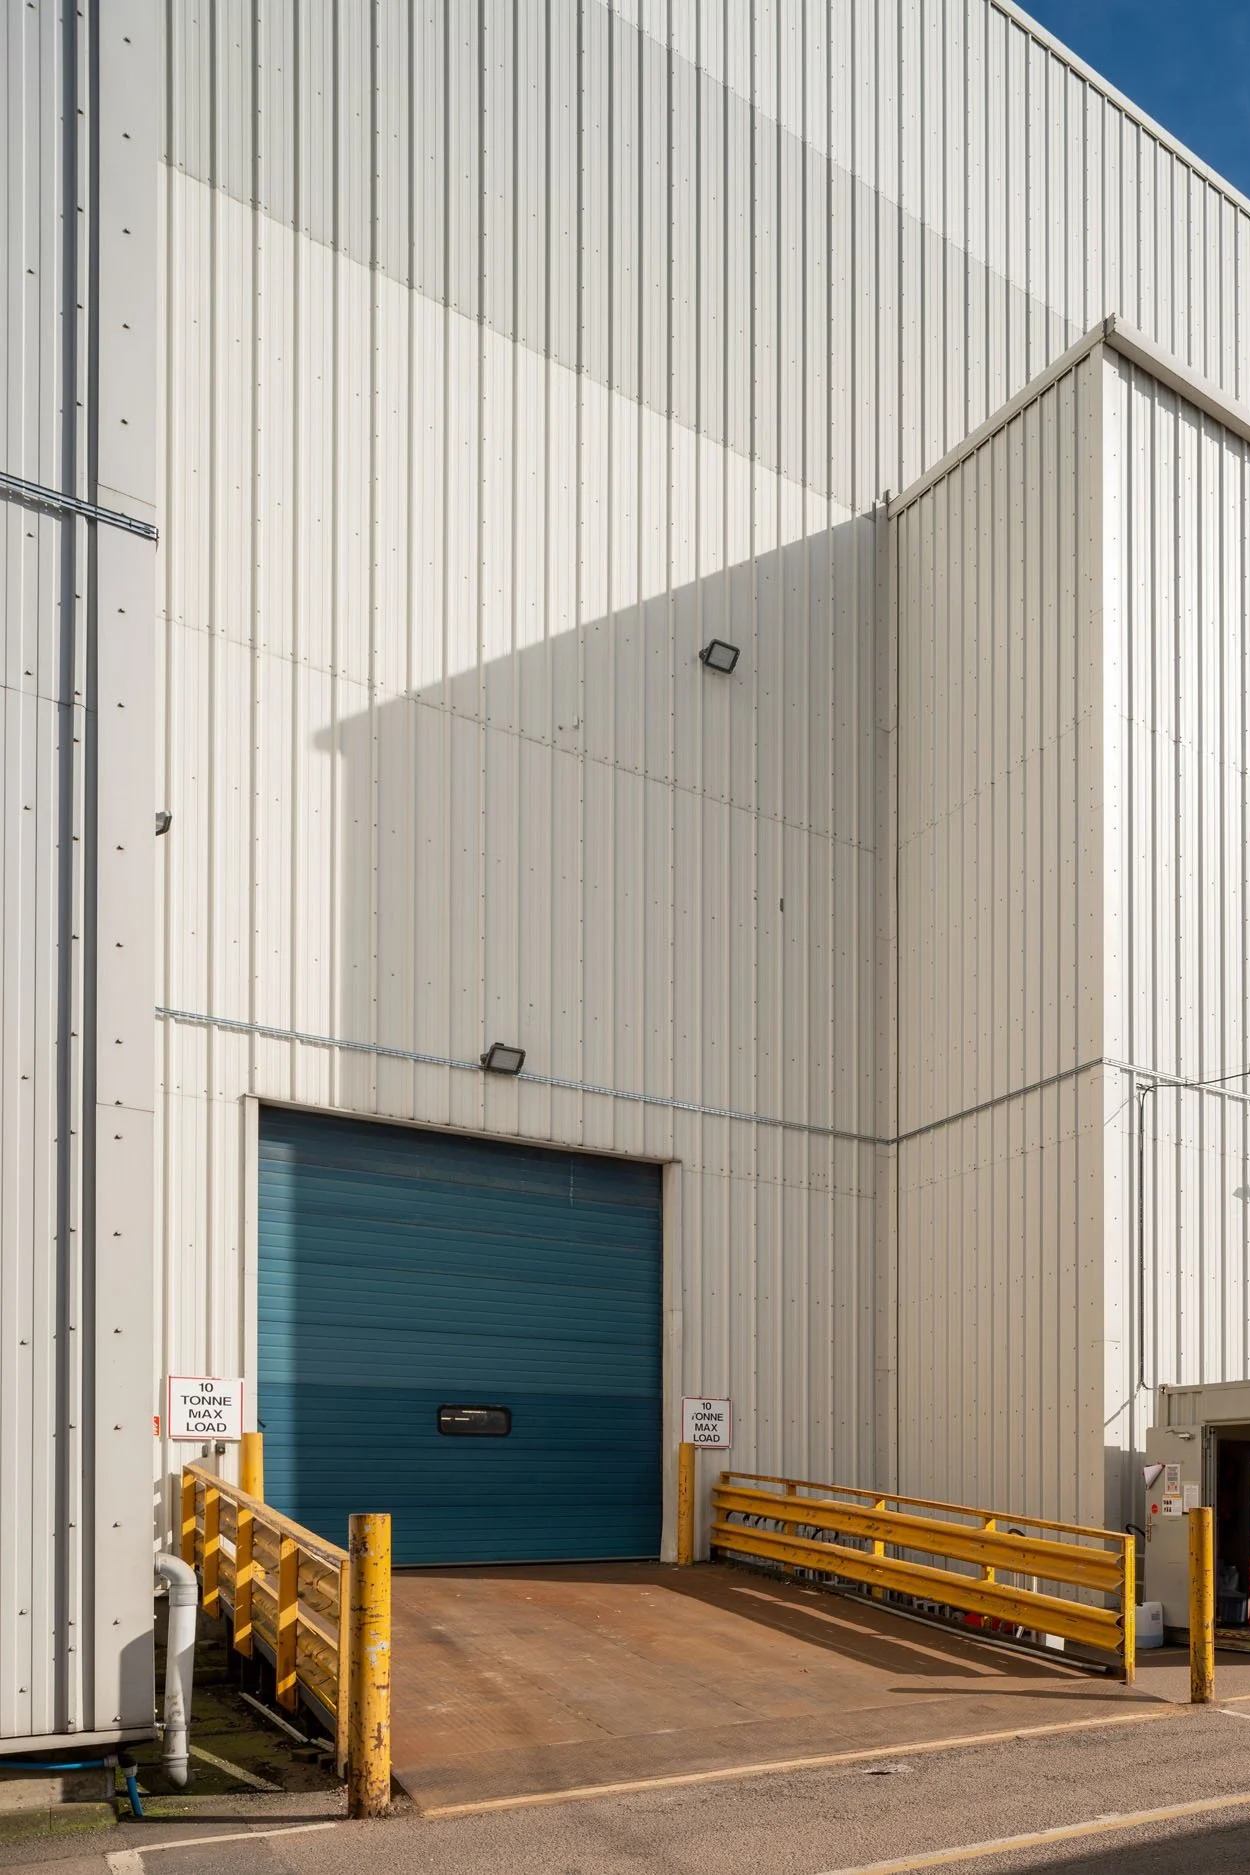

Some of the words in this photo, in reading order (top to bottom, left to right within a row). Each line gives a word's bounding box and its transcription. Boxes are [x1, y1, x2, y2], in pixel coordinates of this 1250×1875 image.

[199, 1383, 214, 1393] 10
[180, 1395, 232, 1406] TONNE
[702, 1402, 712, 1410] 10
[188, 1409, 223, 1419] MAX
[186, 1422, 227, 1432] LOAD
[694, 1423, 718, 1432] MAX
[693, 1434, 721, 1442] LOAD
